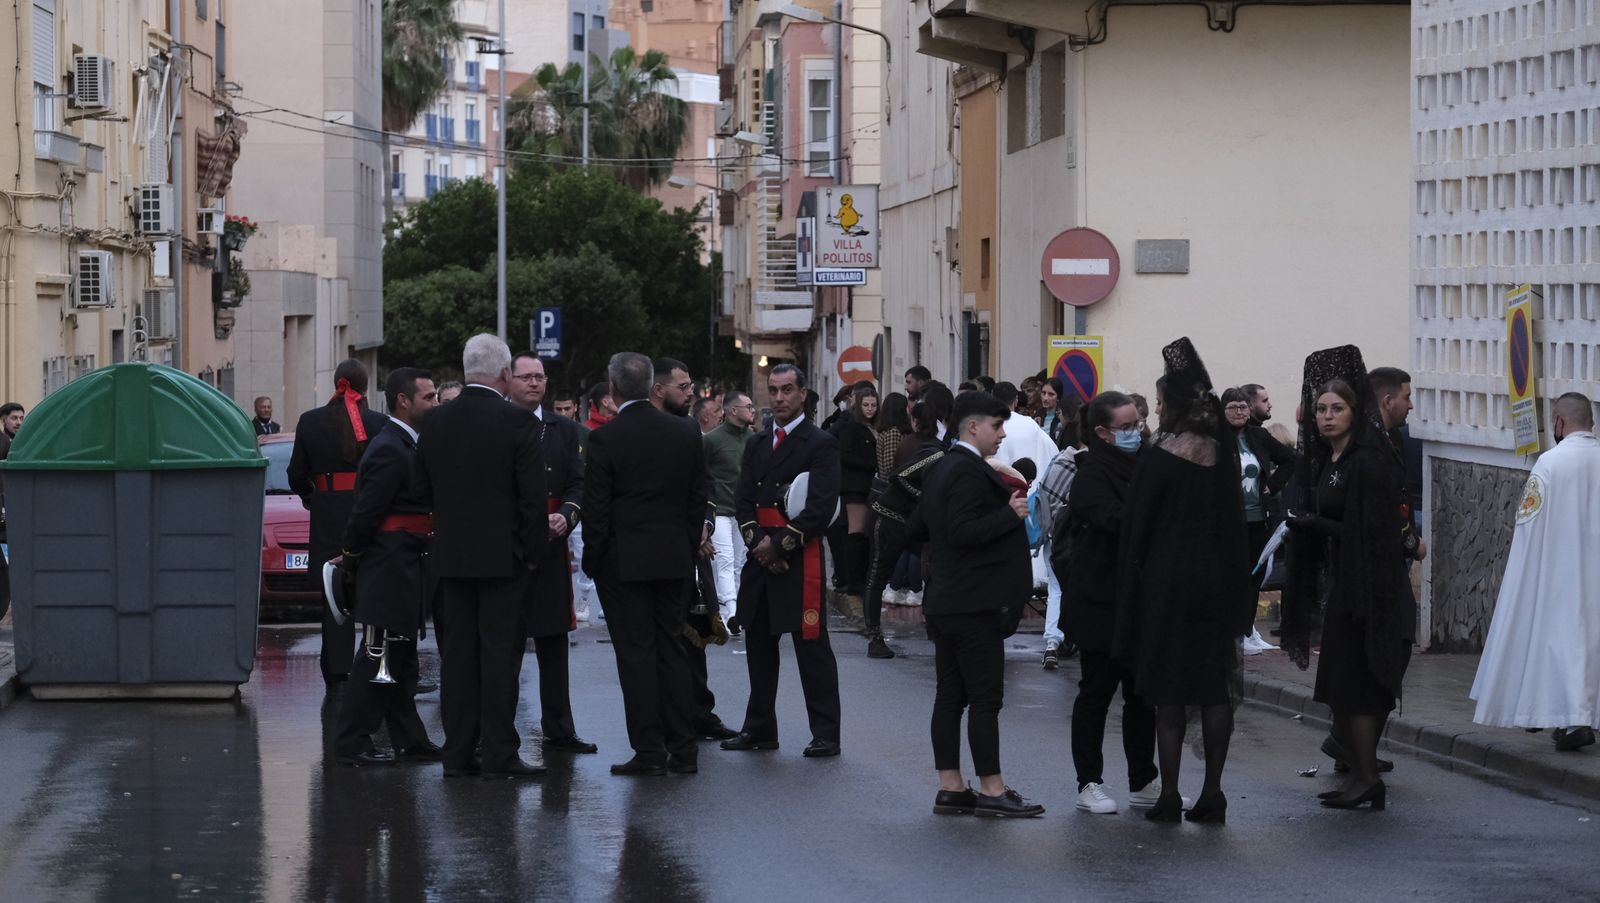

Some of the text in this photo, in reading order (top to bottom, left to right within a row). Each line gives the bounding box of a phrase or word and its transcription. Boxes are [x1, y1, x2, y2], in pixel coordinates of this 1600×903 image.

[833, 240, 862, 250] VILLA
[823, 252, 873, 264] POLLITOS
[817, 272, 862, 281] VETERINARIO
[540, 311, 555, 338] P
